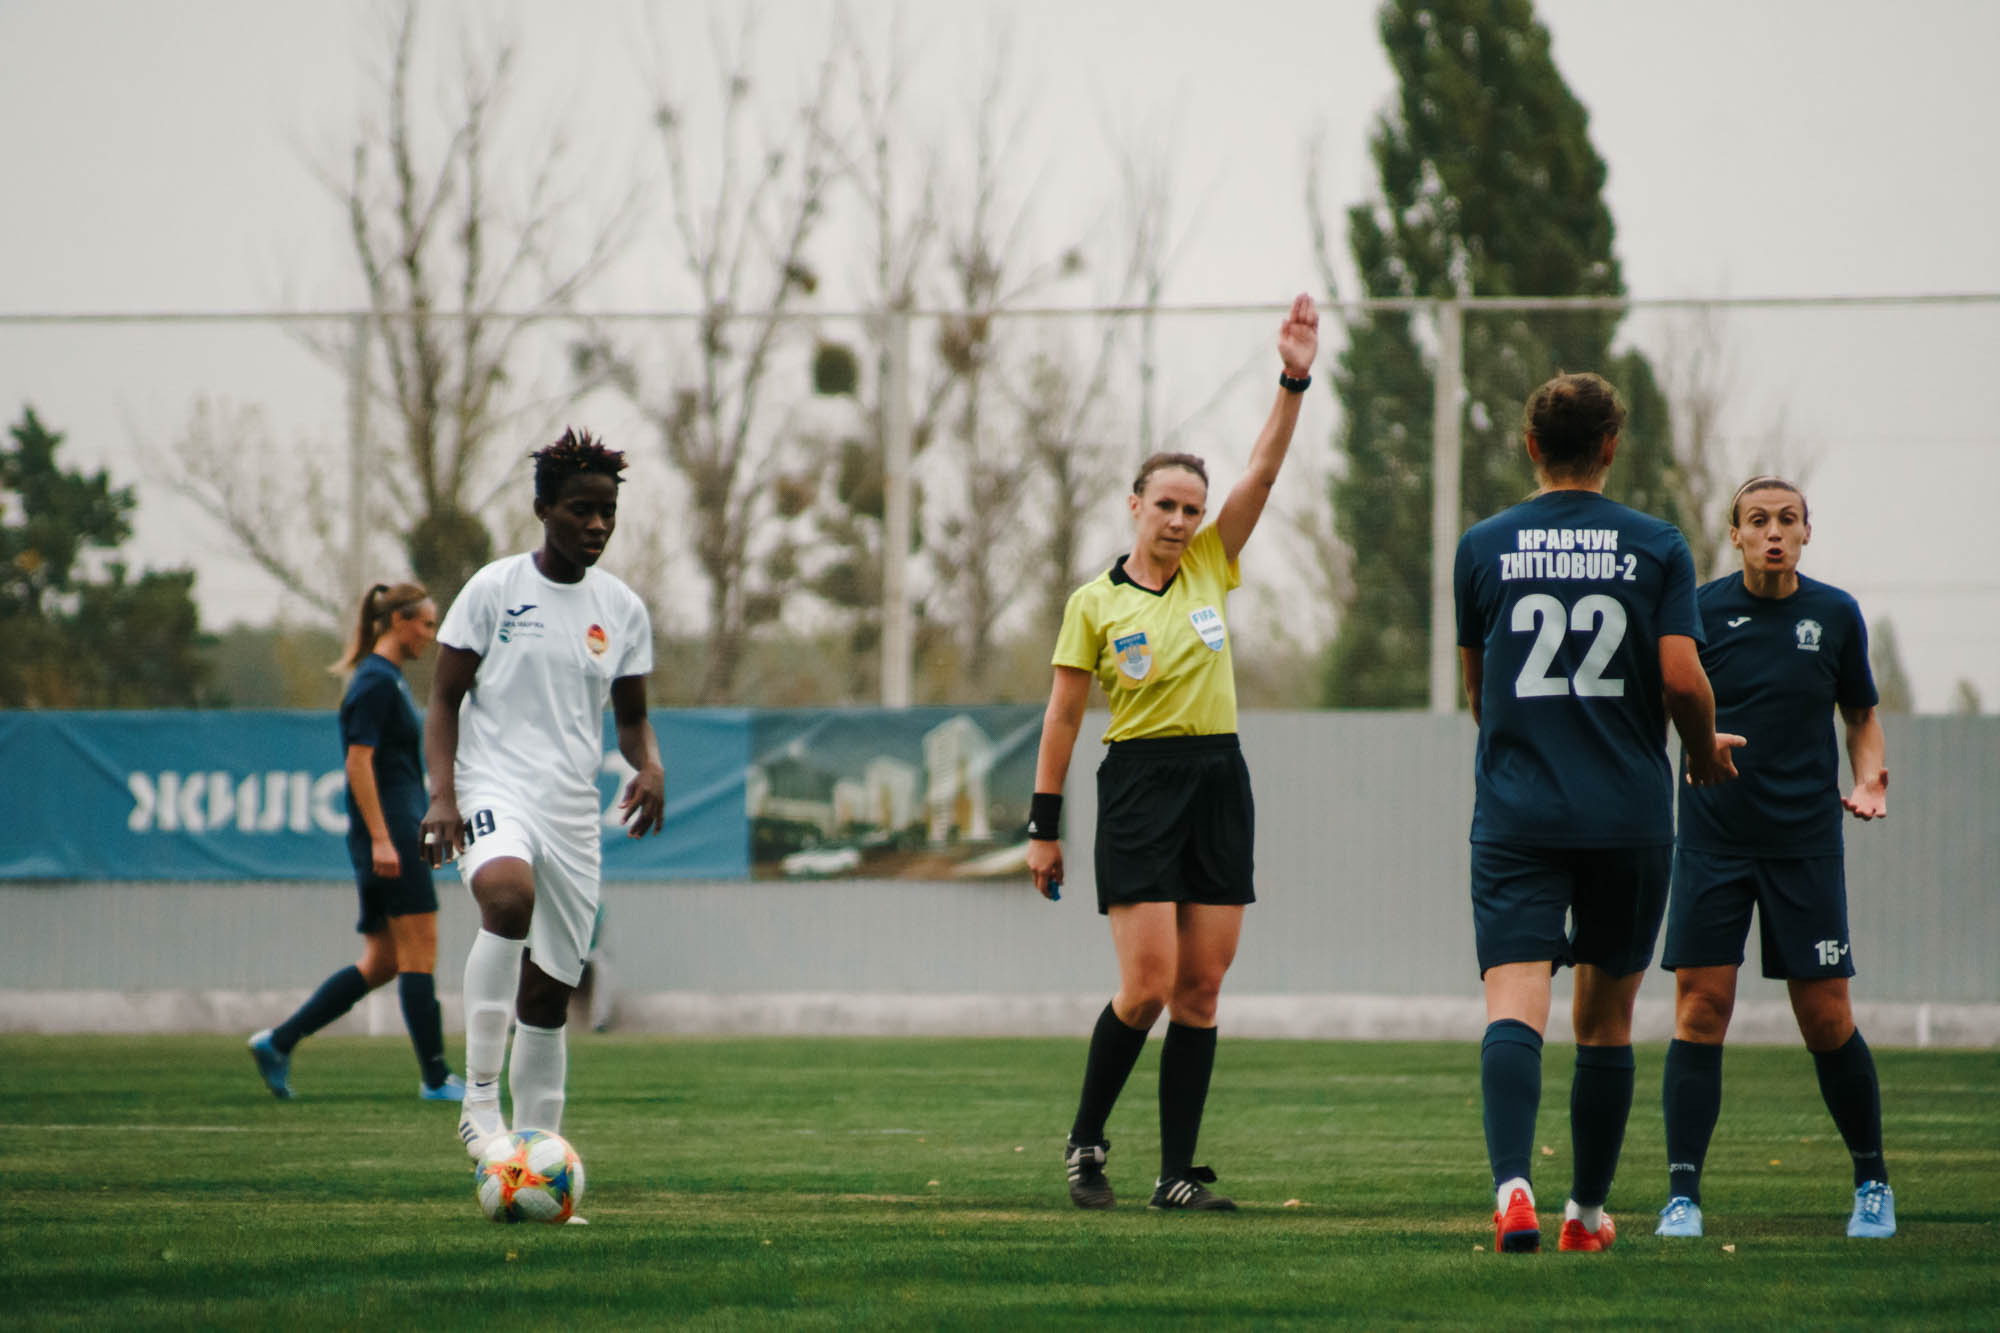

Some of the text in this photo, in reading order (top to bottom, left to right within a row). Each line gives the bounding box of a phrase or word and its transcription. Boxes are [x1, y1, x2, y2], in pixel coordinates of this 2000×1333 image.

[1518, 529, 1619, 551] КРАВЧУК
[1500, 552, 1638, 581] ZHITLOBUD-2
[1511, 593, 1628, 698] 22
[1814, 940, 1840, 966] 15
